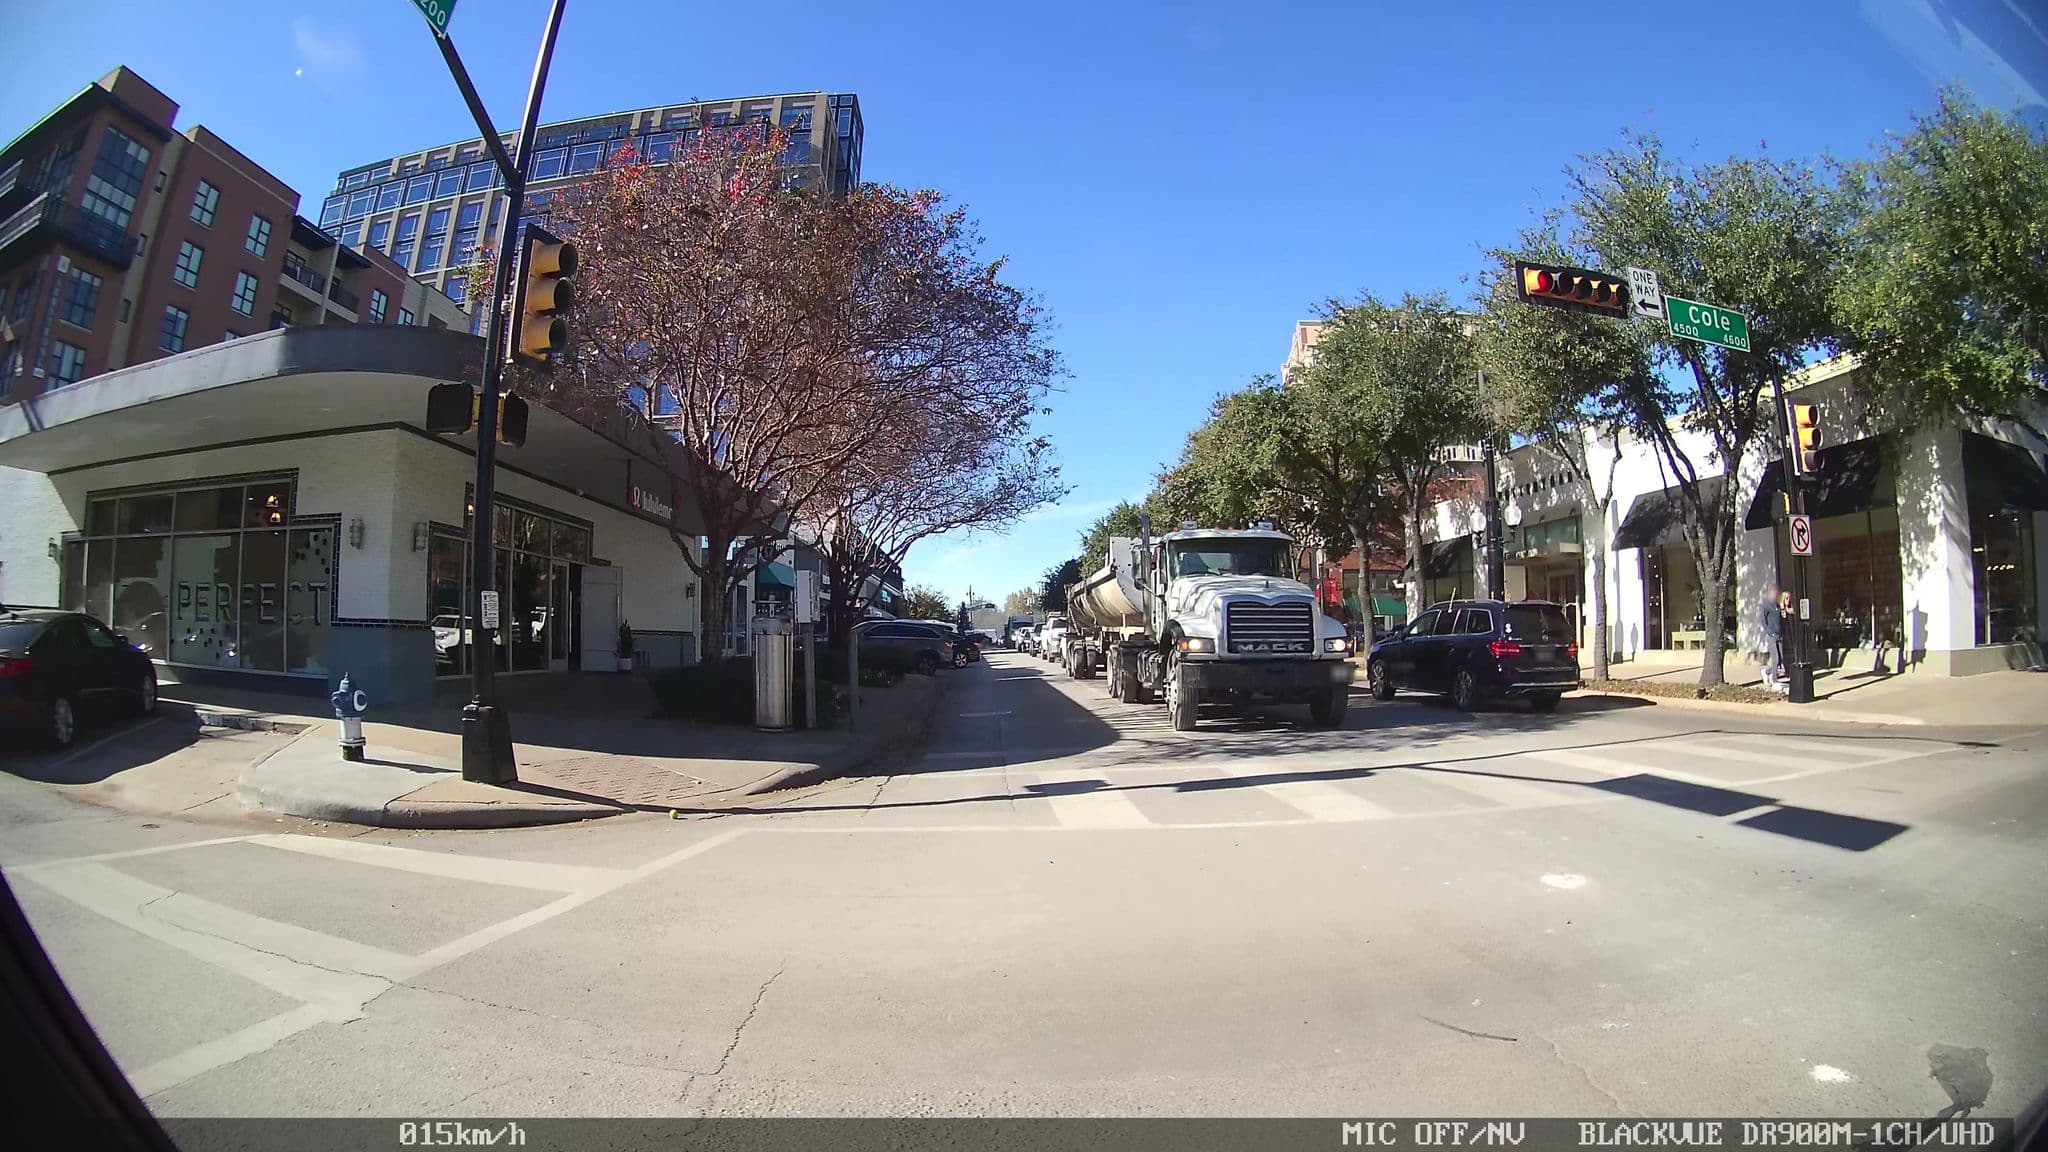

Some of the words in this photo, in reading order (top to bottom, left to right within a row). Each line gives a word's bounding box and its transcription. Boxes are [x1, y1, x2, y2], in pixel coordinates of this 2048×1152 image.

[1632, 270, 1653, 285] ONE
[1635, 284, 1656, 298] WAY
[1688, 305, 1731, 332] Cole
[1673, 322, 1699, 337] 4500
[1723, 334, 1747, 348] 4600
[1237, 643, 1305, 652] MACK
